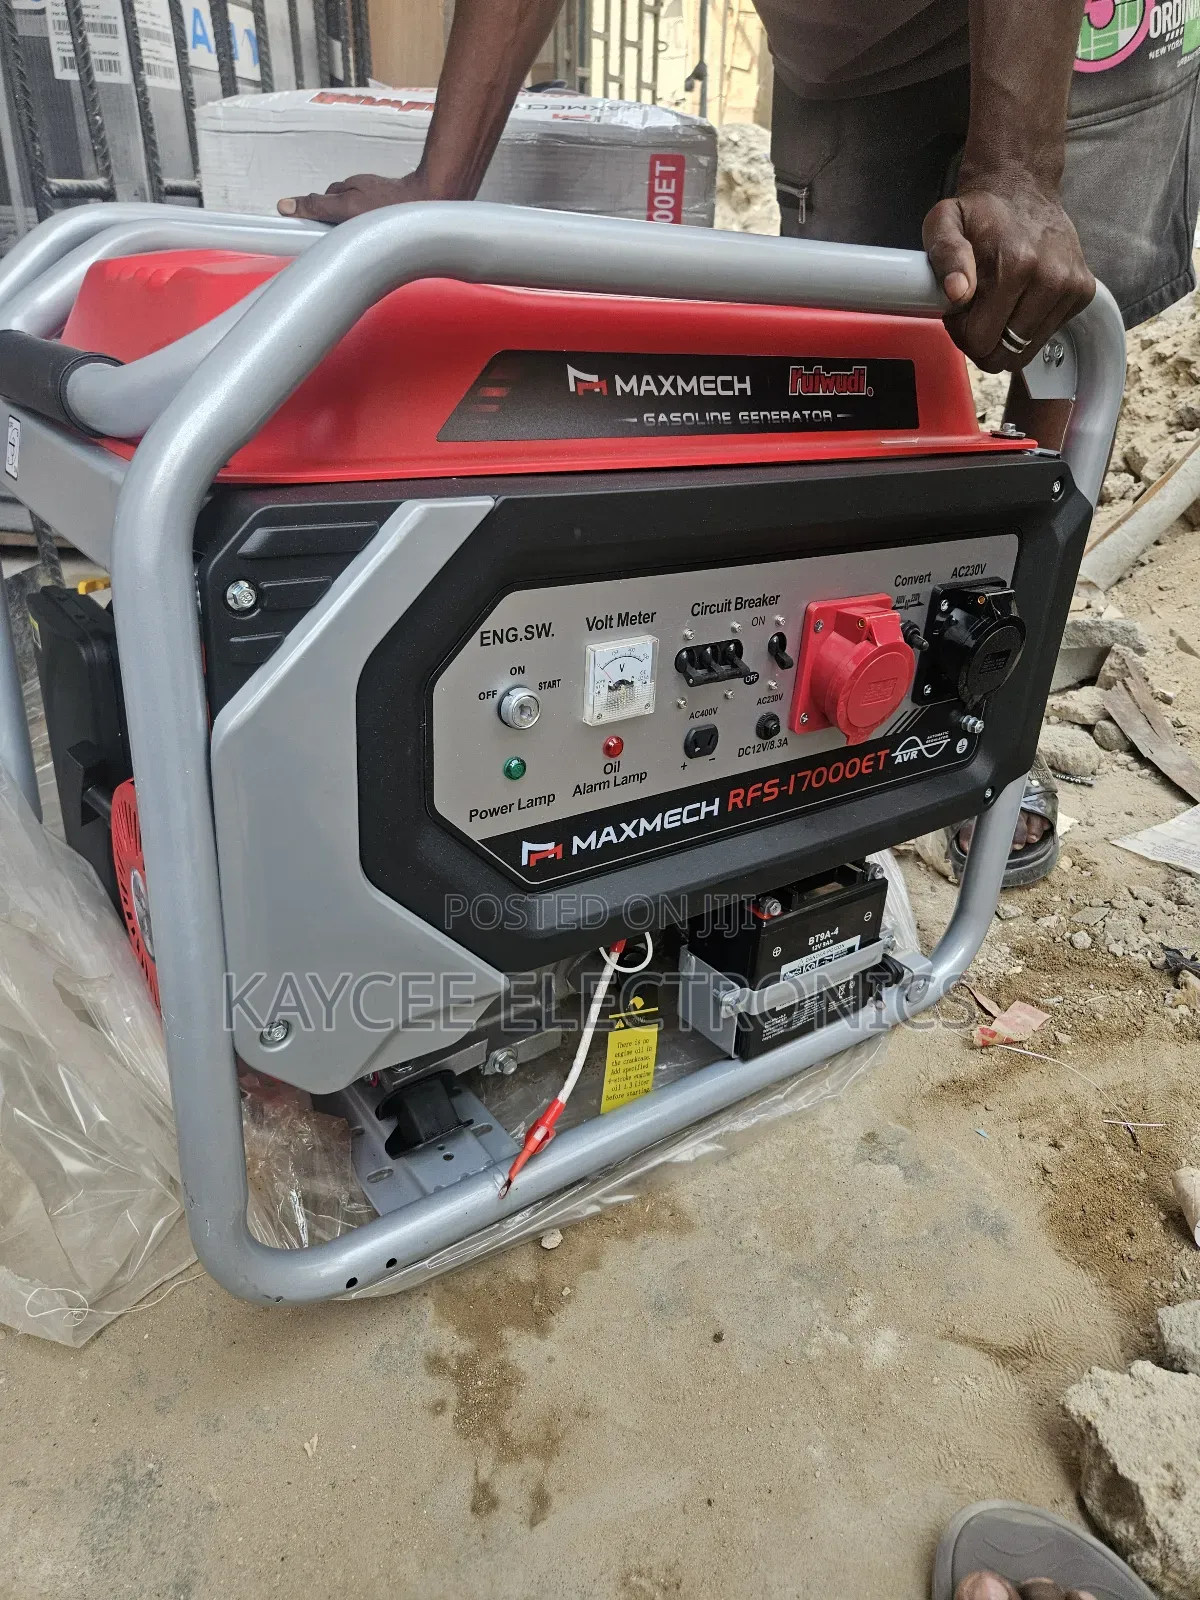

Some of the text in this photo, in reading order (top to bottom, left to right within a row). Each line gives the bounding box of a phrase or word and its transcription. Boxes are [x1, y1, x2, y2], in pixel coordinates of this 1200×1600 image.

[615, 375, 751, 396] MAXMECH
[643, 410, 832, 427] GASOLINE GENERATOR
[951, 563, 987, 579] AC230V
[894, 571, 932, 587] Convert
[690, 593, 780, 617] Circuit Breaker
[586, 610, 656, 632] Volt Meter
[751, 615, 766, 627] ON
[480, 622, 555, 647] ENG.SW.
[509, 666, 525, 676] ON
[745, 673, 758, 683] OFF
[538, 679, 561, 691] START
[478, 690, 498, 701] OFF
[756, 693, 783, 706] AC230V
[689, 706, 718, 720] AC400V
[737, 737, 788, 758] DC12V/8.3A
[894, 751, 918, 764] AVR
[603, 761, 620, 775] Oil
[572, 770, 648, 798] Alarm Lamp
[468, 792, 556, 823] Power Lamp
[572, 748, 890, 855] MAXMECH RFS-17000ET
[808, 926, 839, 946] BT9A-4
[617, 1041, 632, 1049] There
[614, 1050, 632, 1058] engine
[622, 1063, 649, 1074] specified
[633, 1071, 651, 1079] engine
[611, 1084, 621, 1092] oil
[605, 1093, 624, 1101] before
